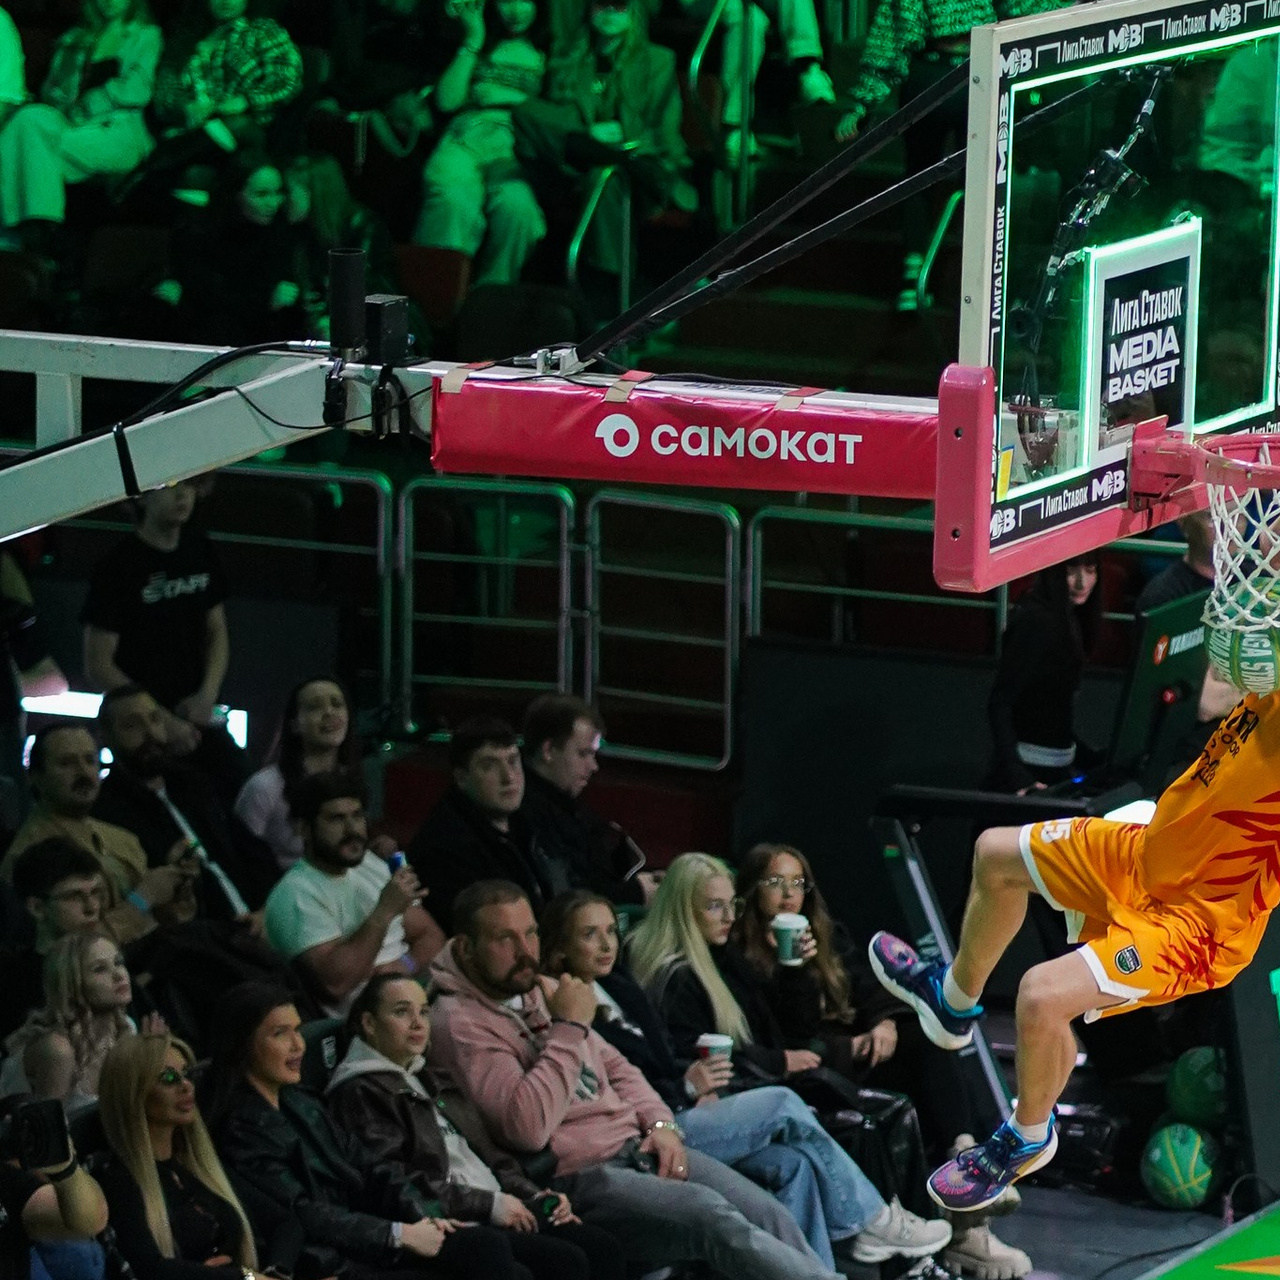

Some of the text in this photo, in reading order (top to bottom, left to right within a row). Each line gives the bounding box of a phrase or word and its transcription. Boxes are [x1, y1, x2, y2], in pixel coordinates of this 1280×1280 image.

[1109, 325, 1180, 374] MEDIA
[1108, 359, 1180, 403] BASKET
[650, 423, 862, 465] самокат
